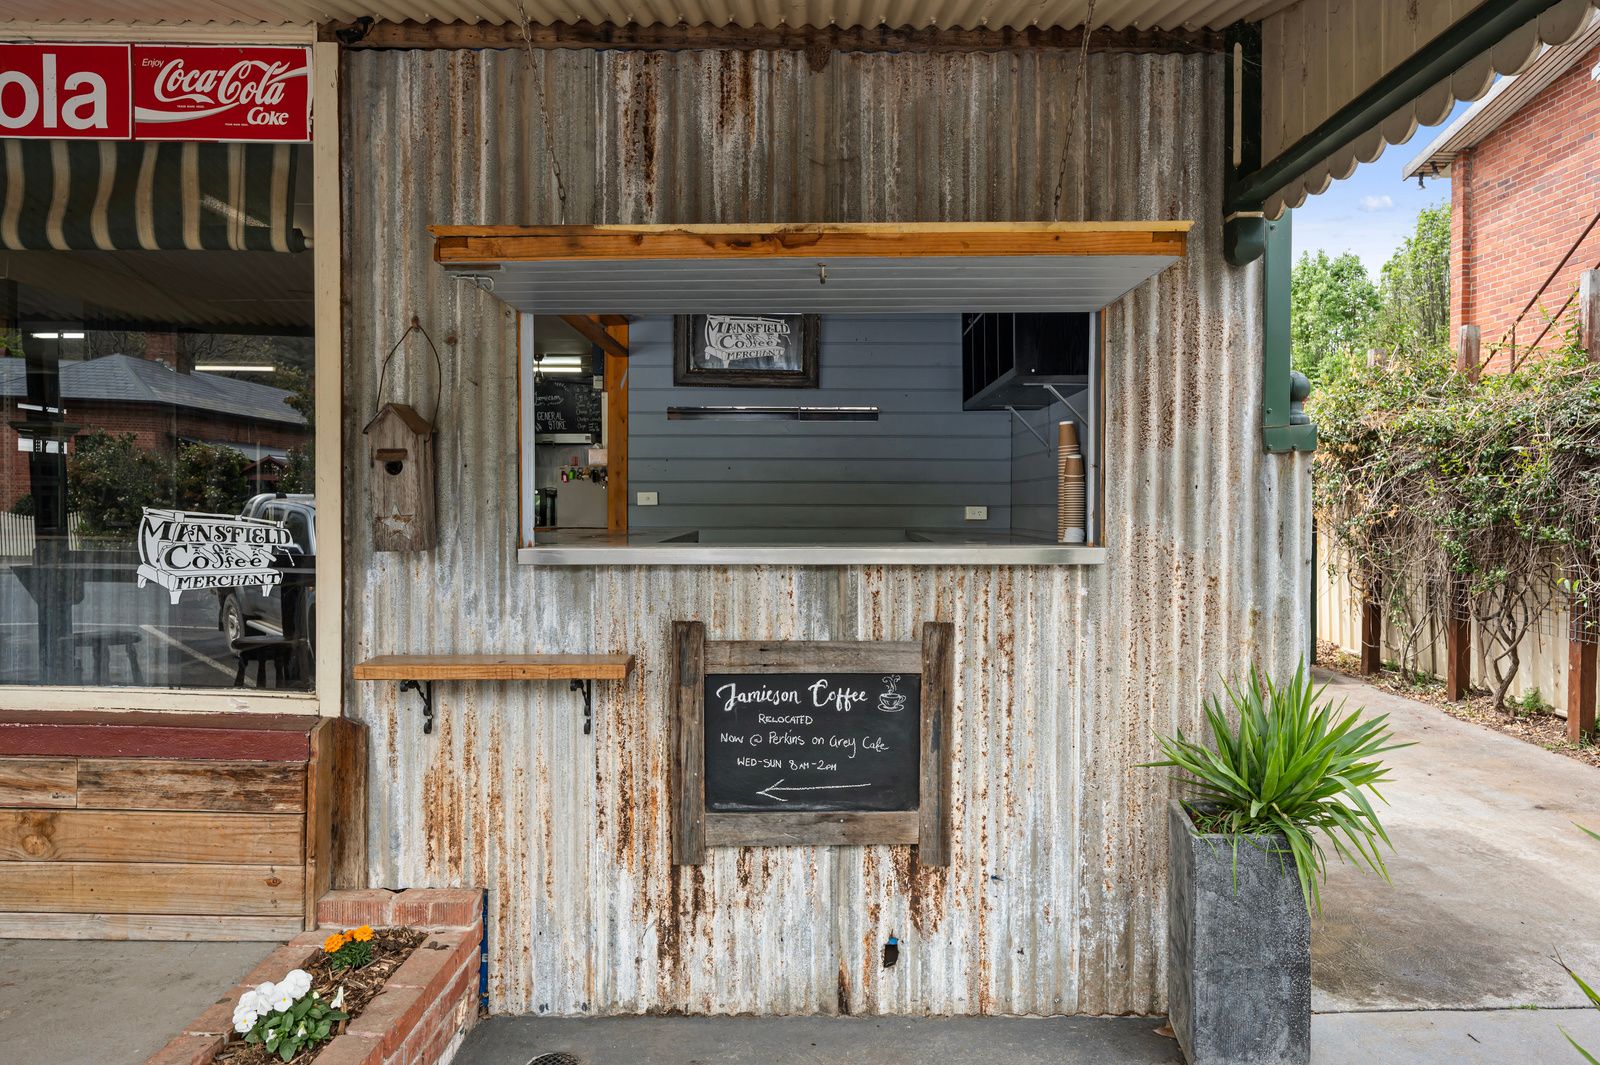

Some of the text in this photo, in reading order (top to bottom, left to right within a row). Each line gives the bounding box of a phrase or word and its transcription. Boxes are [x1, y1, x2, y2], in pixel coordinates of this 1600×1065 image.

[142, 58, 165, 68] Enjoy
[154, 58, 290, 105] Coca-Cola
[247, 107, 289, 126] Coke
[707, 321, 789, 335] MANSFIELD
[720, 335, 774, 349] Coffee
[727, 349, 783, 361] MERCHANT
[143, 517, 291, 547] MANSFIELD
[164, 544, 262, 569] Coffee
[177, 574, 281, 590] MERCHANT
[716, 679, 869, 712] Jamieson Coffee
[758, 713, 813, 725] RELOCATED
[720, 729, 889, 759] Now @ Perkins on Grey Cafe
